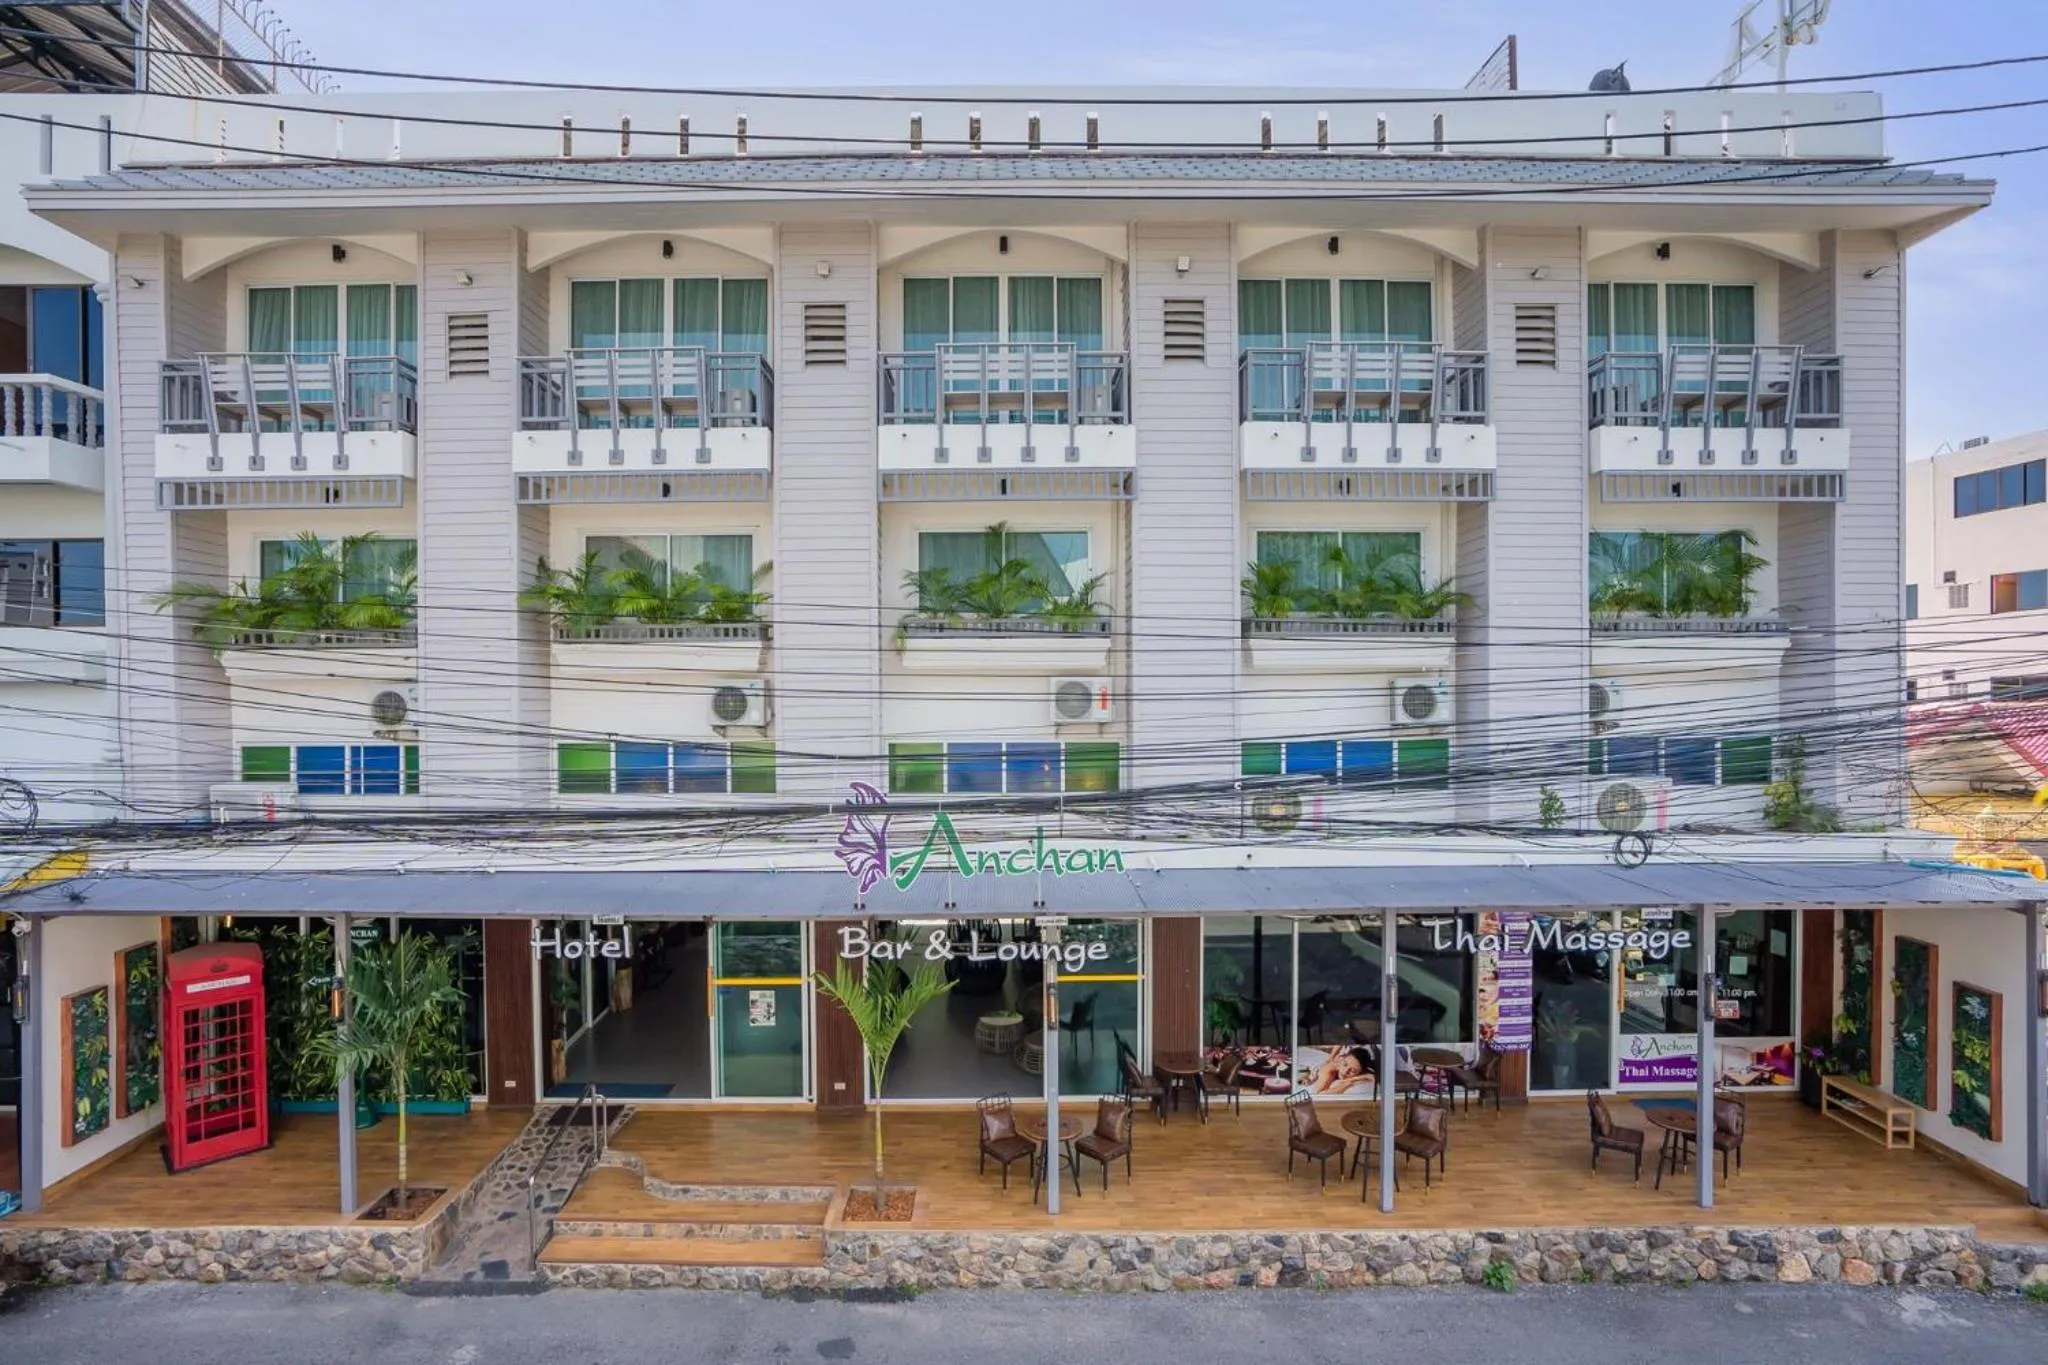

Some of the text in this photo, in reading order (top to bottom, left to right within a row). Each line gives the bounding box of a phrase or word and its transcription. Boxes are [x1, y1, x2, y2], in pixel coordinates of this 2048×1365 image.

[888, 812, 1126, 891] Anchan
[350, 929, 378, 938] NCHAN
[531, 926, 634, 960] Hotel
[837, 926, 1109, 973] Bar & Lounge
[1421, 919, 1693, 960] Thai Massage
[1624, 1067, 1649, 1077] Thai
